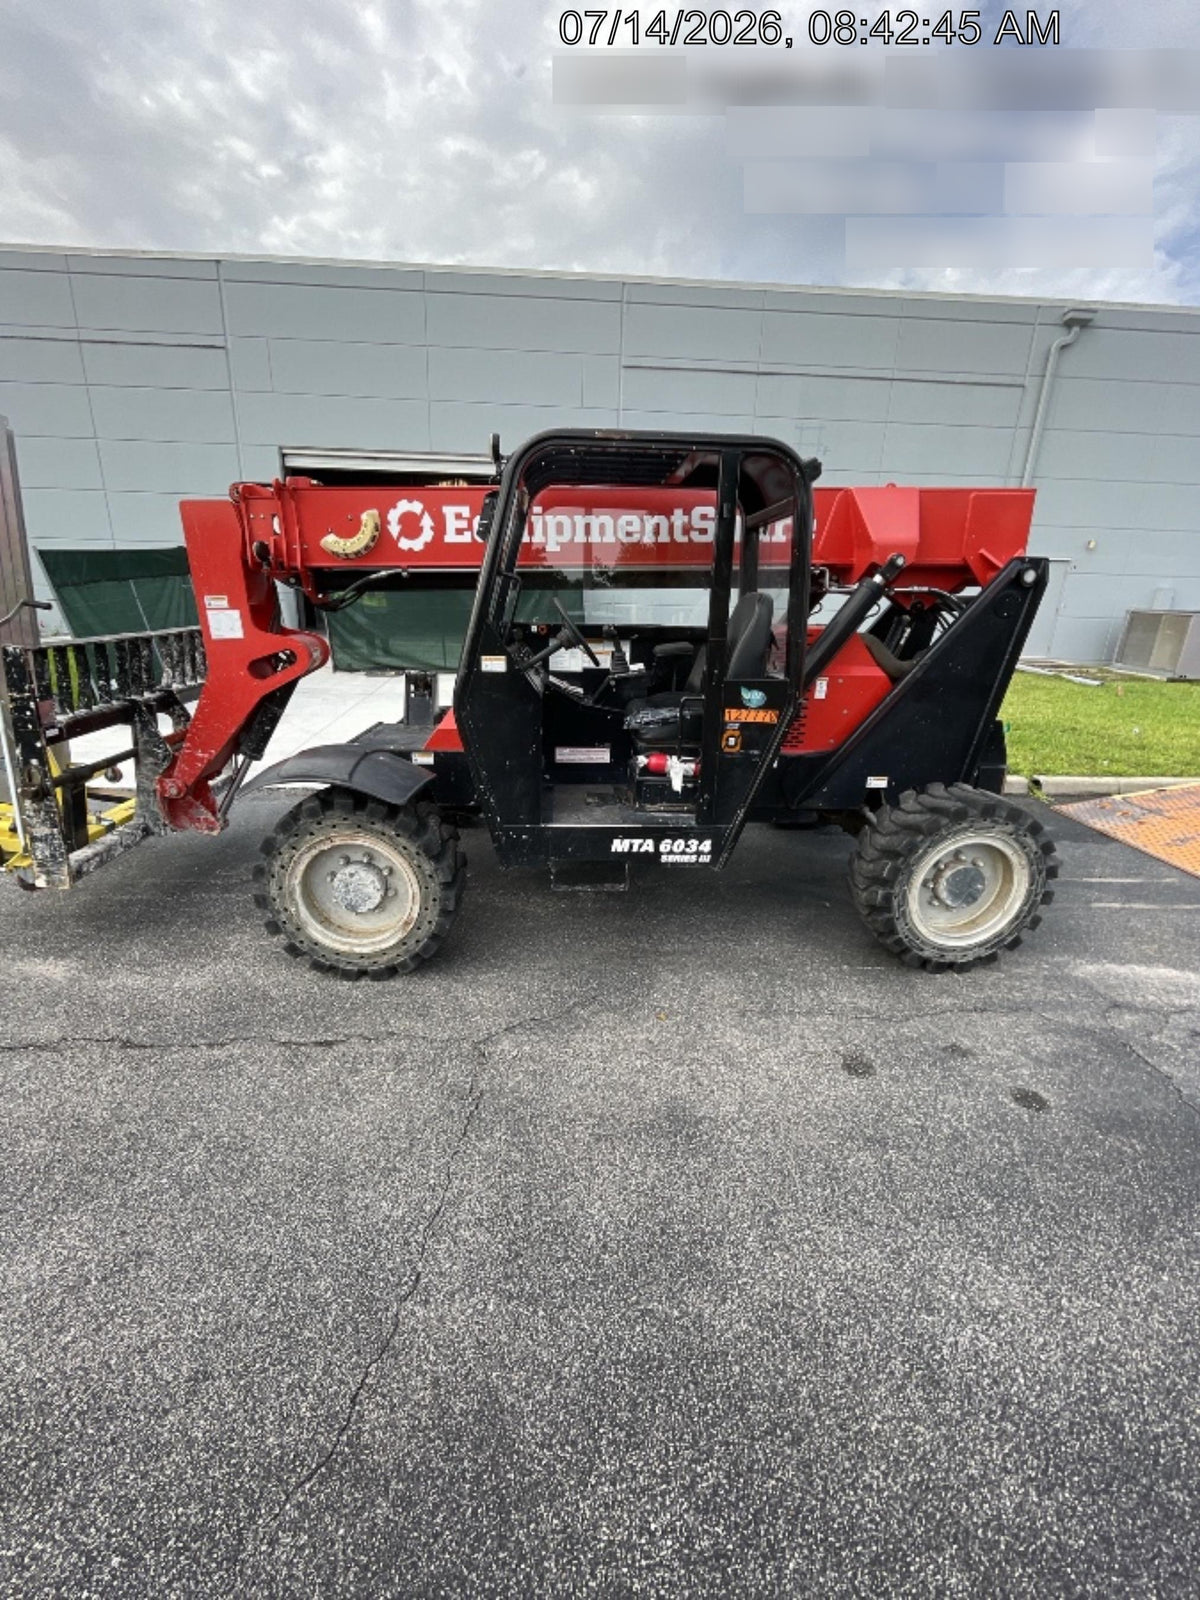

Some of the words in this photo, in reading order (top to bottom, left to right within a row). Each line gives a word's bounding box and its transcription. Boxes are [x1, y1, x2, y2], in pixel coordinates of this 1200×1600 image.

[441, 505, 817, 552] EipmentSr
[610, 838, 655, 853] MTA
[659, 838, 713, 854] 6034
[660, 854, 698, 863] SERIES
